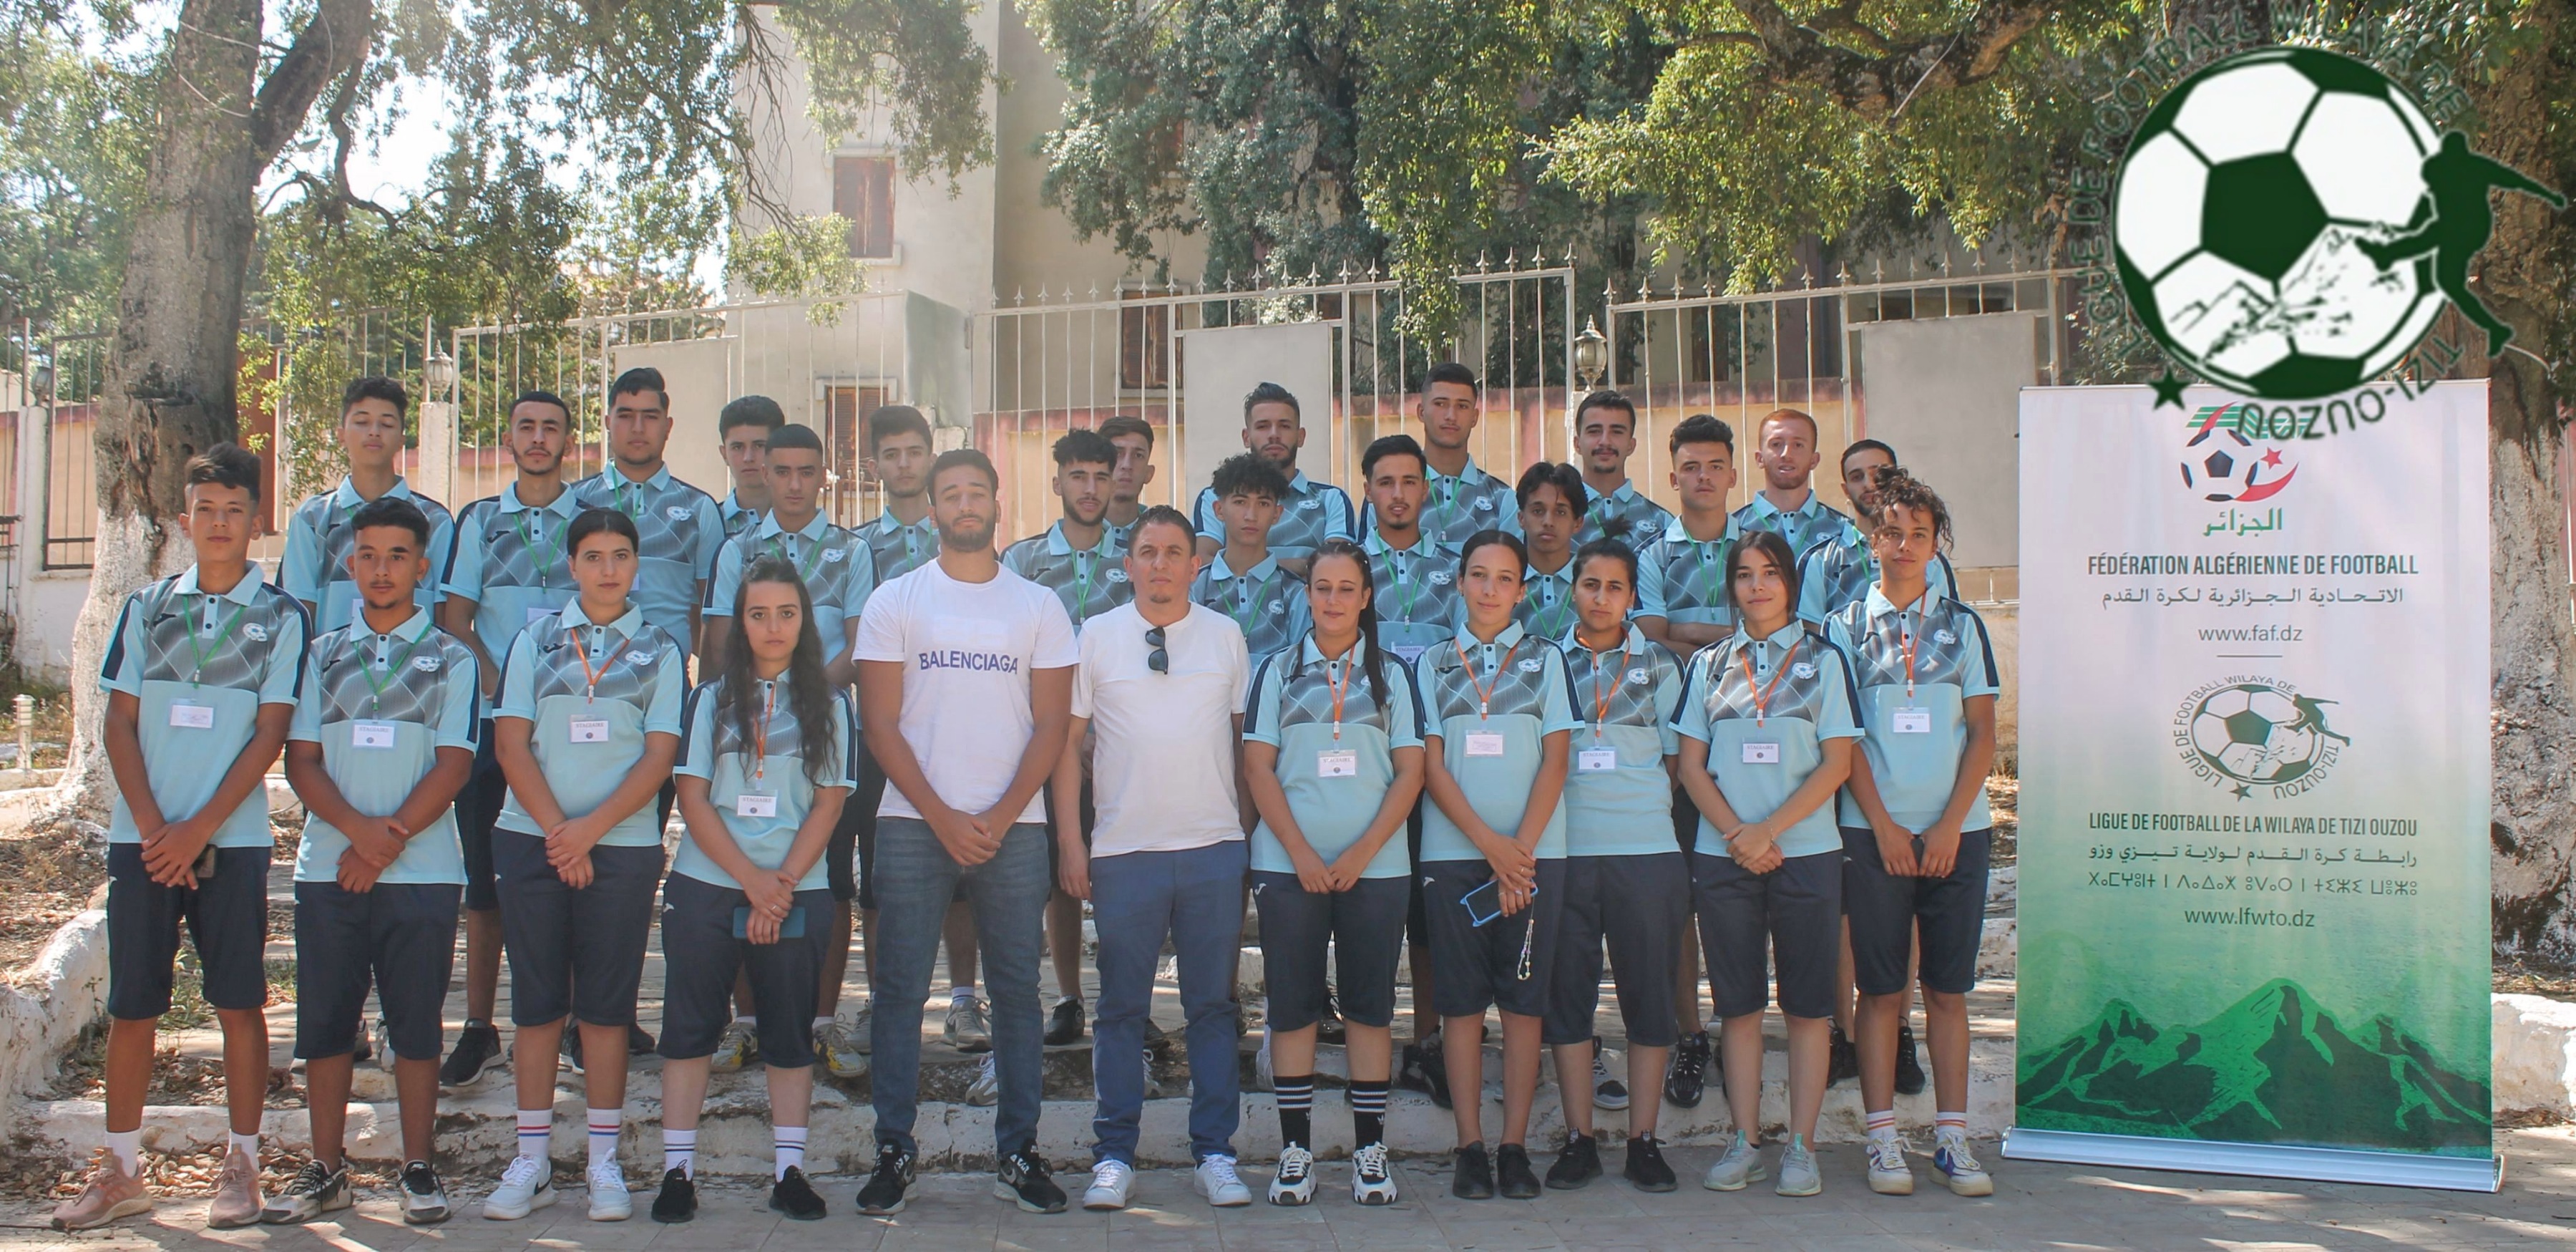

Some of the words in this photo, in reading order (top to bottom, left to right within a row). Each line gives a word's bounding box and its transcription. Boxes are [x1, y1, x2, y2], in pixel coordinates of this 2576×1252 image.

[2202, 508, 2283, 537] الجزائر
[2087, 552, 2188, 575] FÉDÉRATION
[2192, 551, 2299, 575] ALGÉRIENNE
[2304, 554, 2326, 575] DE
[2331, 554, 2419, 575] FOOTBALL
[2102, 588, 2150, 611] القدم
[2156, 587, 2201, 606] لكرة
[2197, 624, 2303, 642] www.faf.dz
[918, 649, 1019, 674] BALENCIAGA
[2224, 675, 2274, 686] WILAYA
[2276, 680, 2297, 693] DE
[2173, 680, 2225, 726] FOOTBALL
[2173, 729, 2190, 747] DE
[2179, 747, 2223, 787] LIGUE
[2273, 745, 2339, 800] TIZI-OUZOU
[2089, 812, 2128, 830] LIGUE
[2132, 813, 2149, 830] DE
[2152, 813, 2221, 833] FOOTBALL
[2223, 815, 2241, 833] DE
[2245, 816, 2262, 833] LA
[2265, 816, 2316, 835] WILAYA
[2318, 817, 2337, 835] DE
[2339, 817, 2366, 835] TIZI
[2369, 818, 2417, 837] OUZOU
[2089, 845, 2113, 859] وزو
[2314, 848, 2348, 865] كرة
[2184, 907, 2316, 928] www.lfwto.dz
